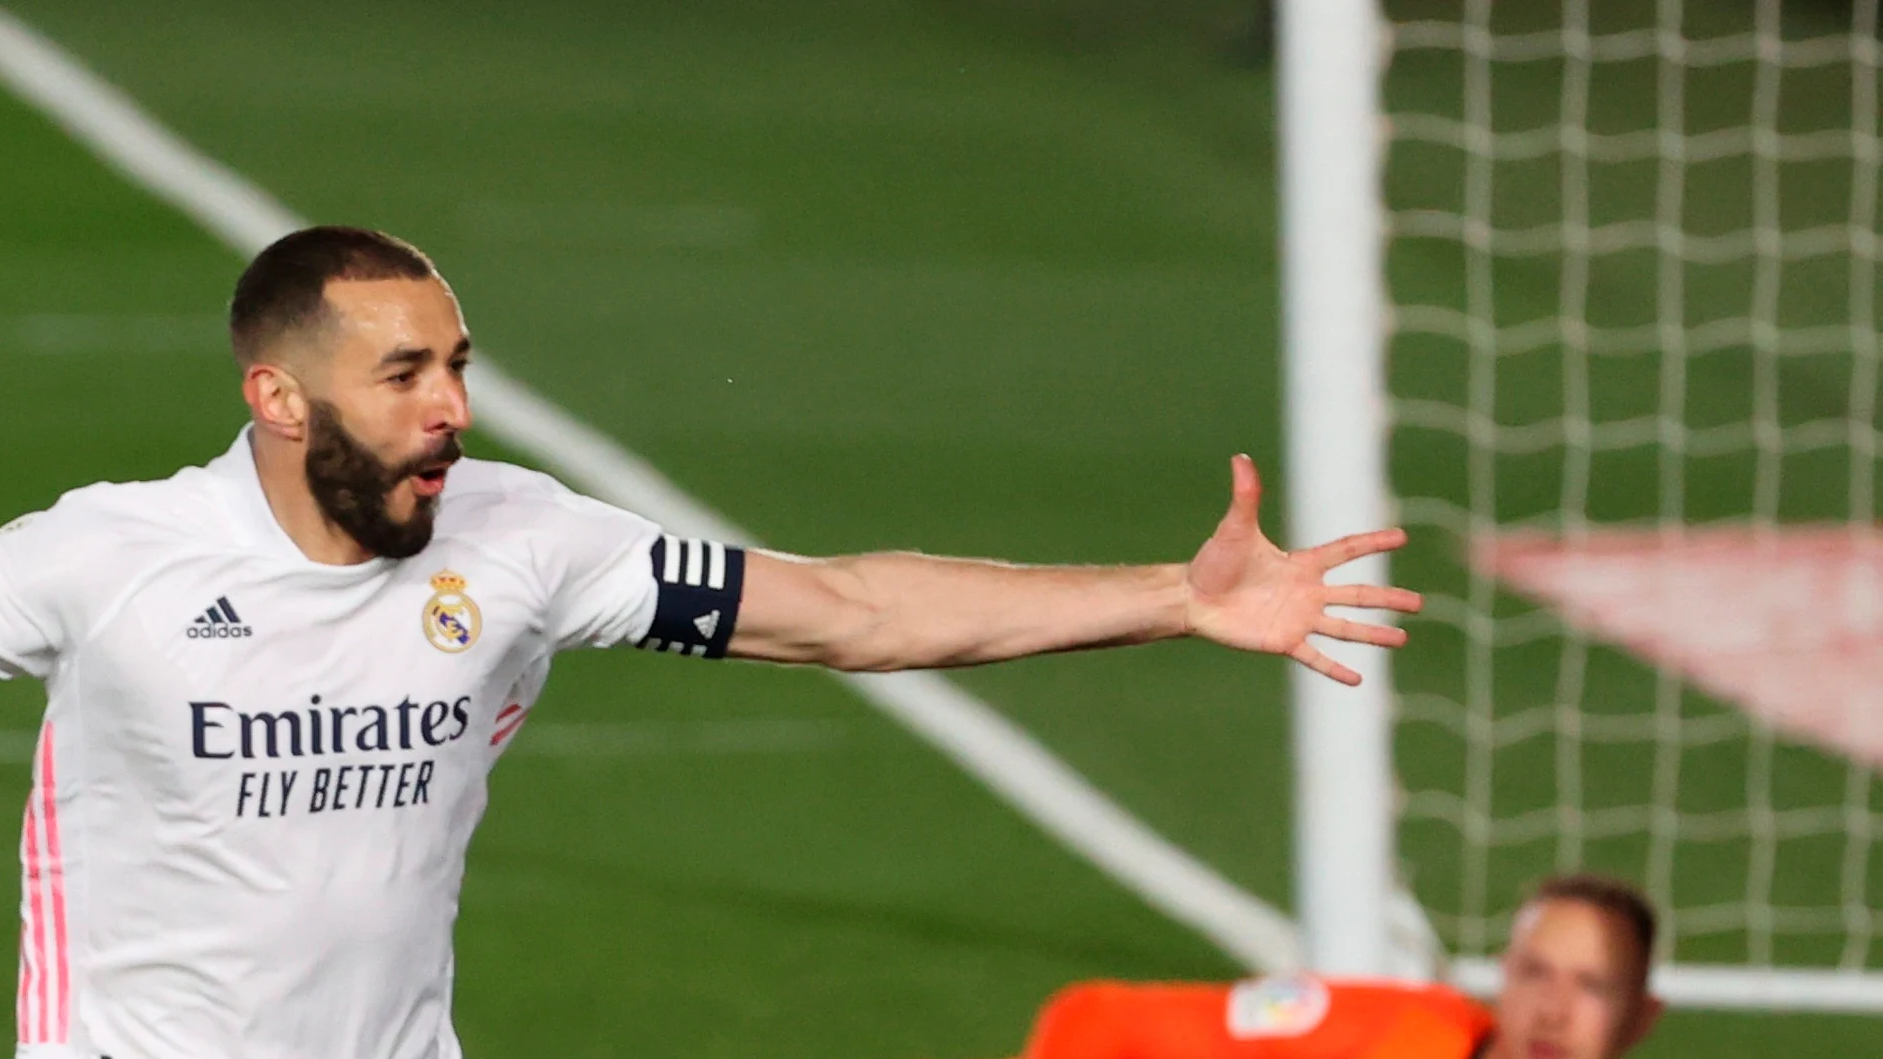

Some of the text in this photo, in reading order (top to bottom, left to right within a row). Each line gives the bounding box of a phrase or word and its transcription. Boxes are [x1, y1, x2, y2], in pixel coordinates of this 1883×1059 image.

[187, 624, 252, 638] adidas
[188, 694, 471, 759] Emirates
[236, 759, 434, 817] FLY BETTER
